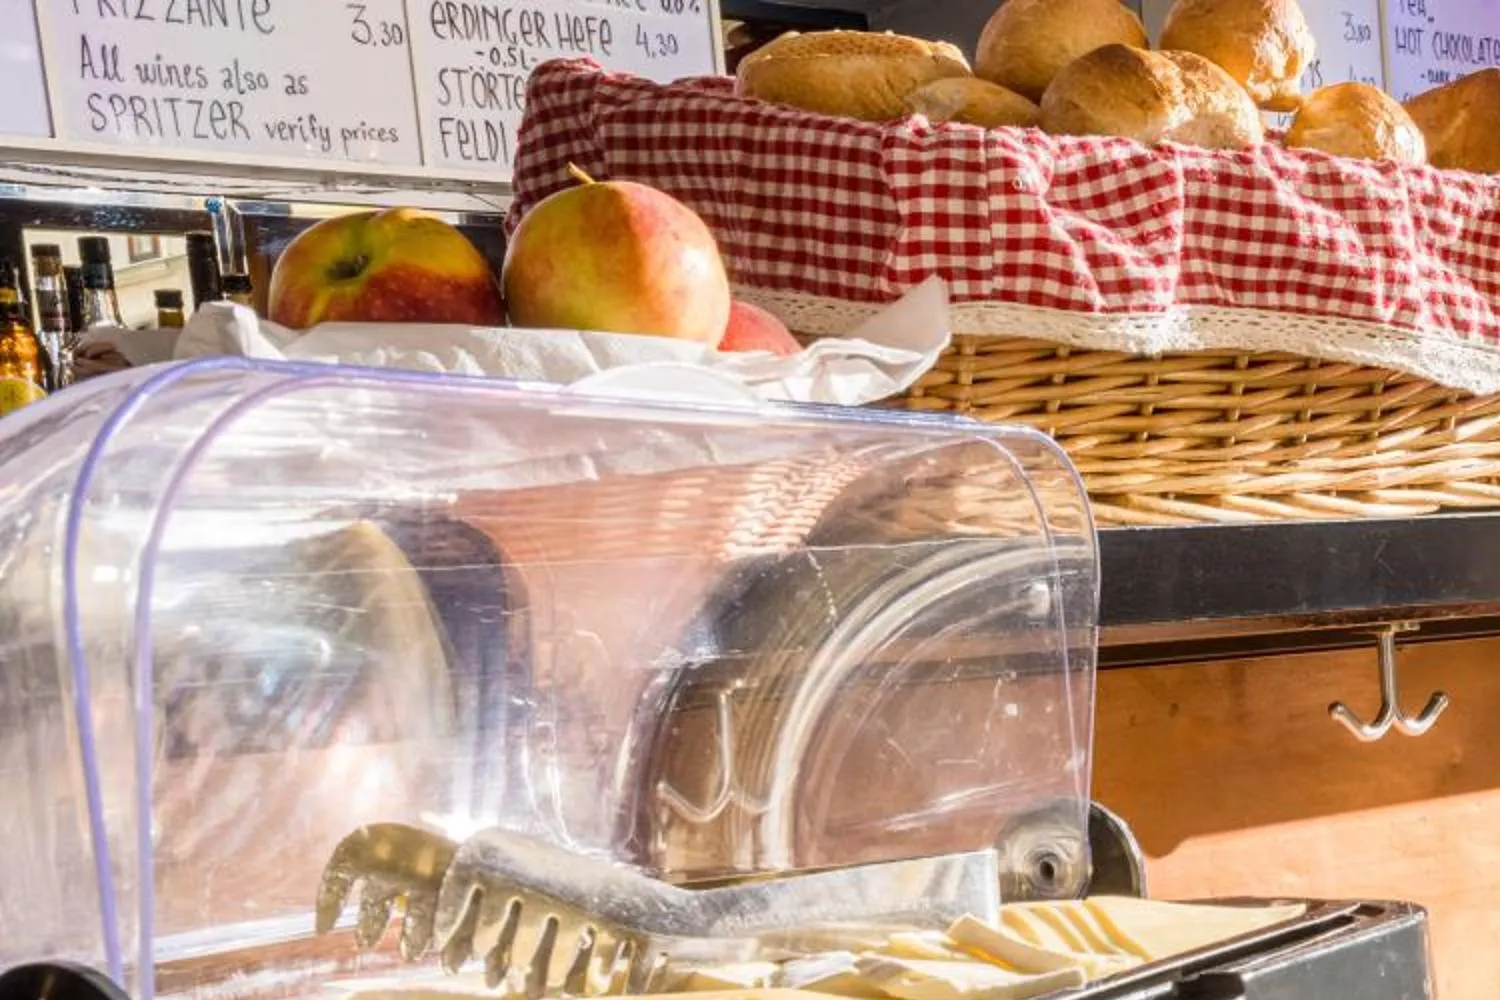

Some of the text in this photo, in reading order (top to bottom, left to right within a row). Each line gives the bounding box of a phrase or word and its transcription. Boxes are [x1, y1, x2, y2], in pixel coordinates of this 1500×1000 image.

[347, 4, 404, 46] 3.30
[1395, 25, 1424, 55] HOT
[80, 34, 309, 95] All wines also as
[265, 113, 331, 152] verify
[340, 120, 399, 156] prices
